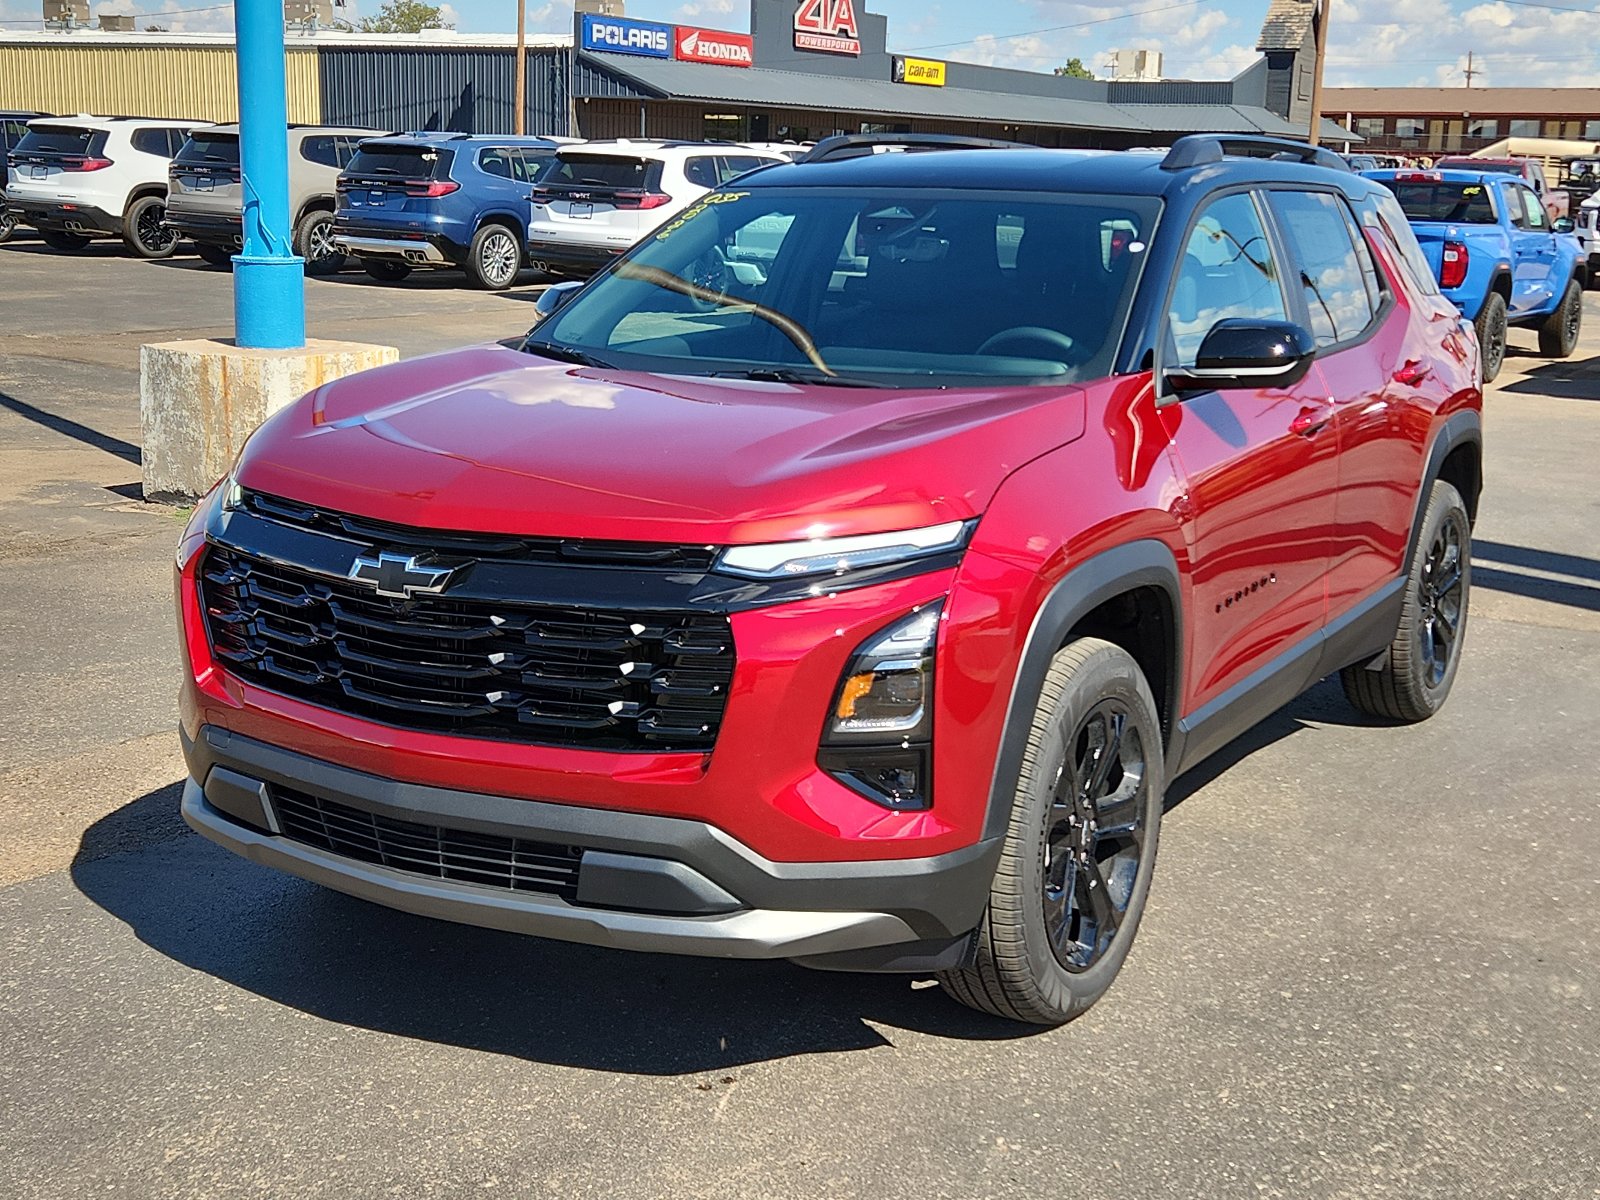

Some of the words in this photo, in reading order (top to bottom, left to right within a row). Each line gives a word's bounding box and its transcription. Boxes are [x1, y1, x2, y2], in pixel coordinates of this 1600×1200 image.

[795, 0, 858, 38] ZIA
[592, 24, 667, 50] POLARIS
[800, 35, 855, 50] POWERSPORTS
[698, 41, 751, 61] HONDA
[908, 65, 939, 79] can-am
